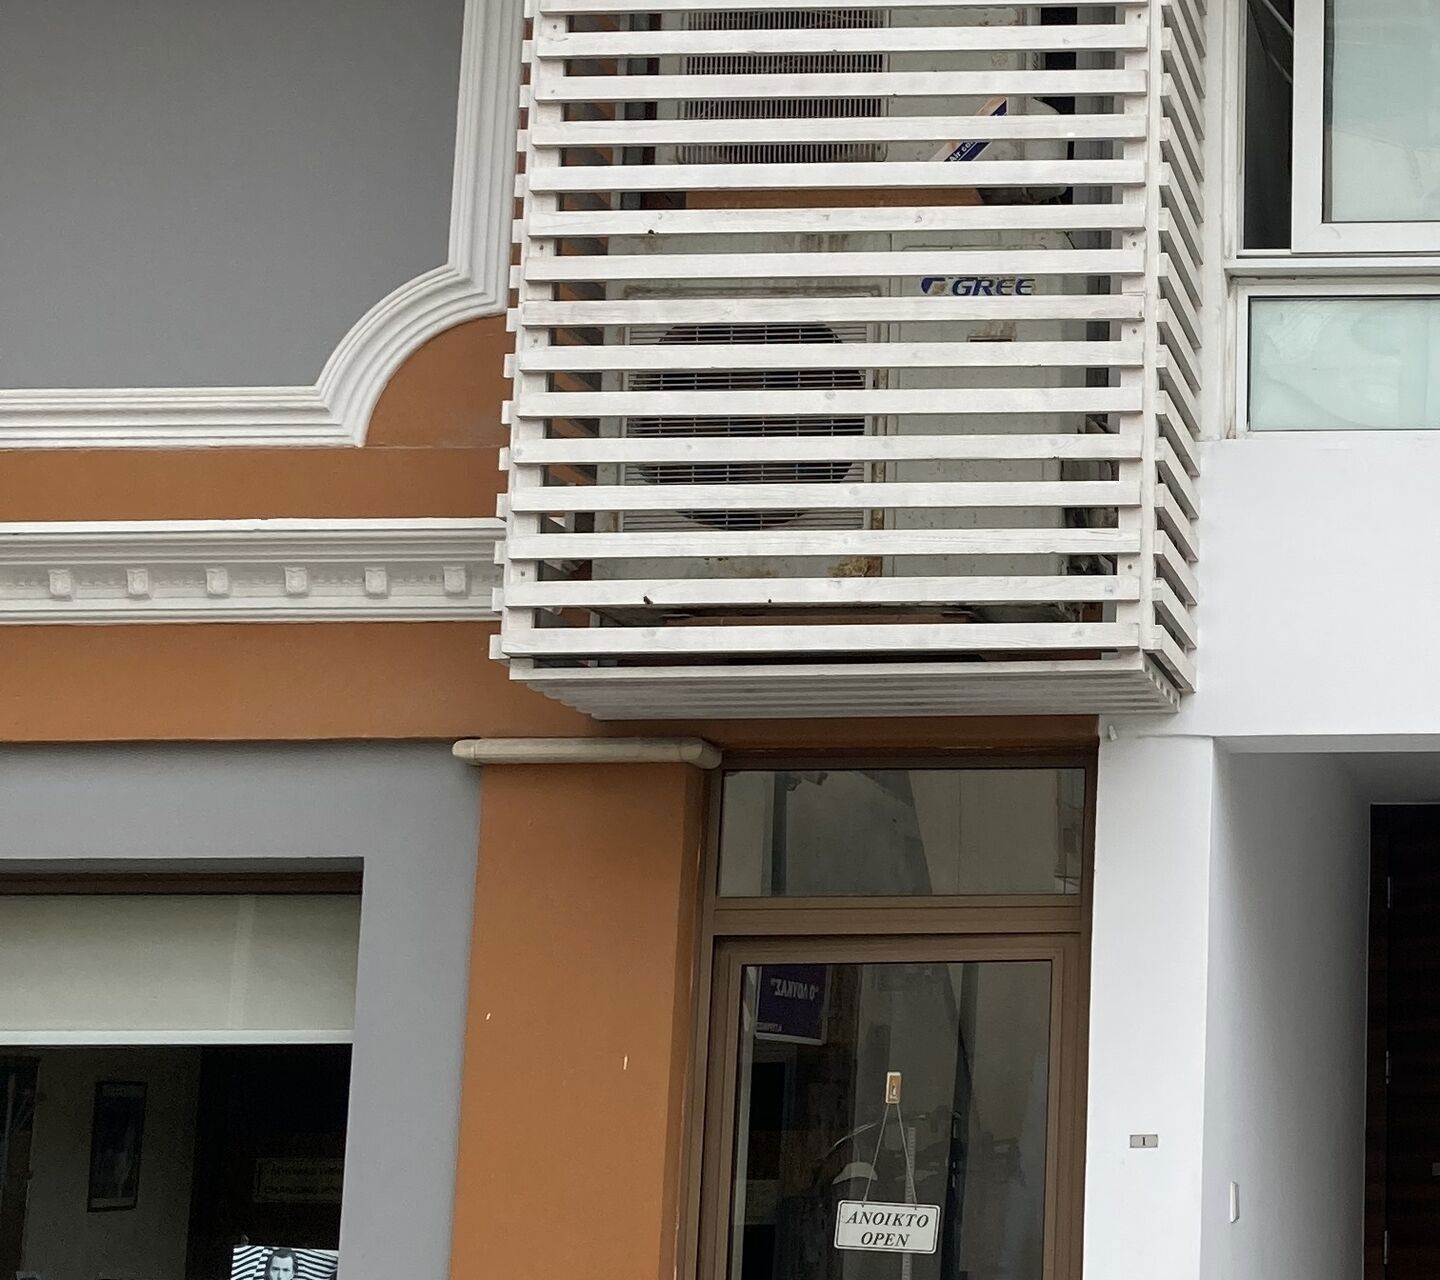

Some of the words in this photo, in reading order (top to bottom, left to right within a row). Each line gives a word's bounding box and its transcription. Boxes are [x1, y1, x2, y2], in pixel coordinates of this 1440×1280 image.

[951, 278, 1036, 297] GREE
[846, 1211, 929, 1228] ΑΝΟΙΚΤΟ
[861, 1231, 910, 1247] OPEN
